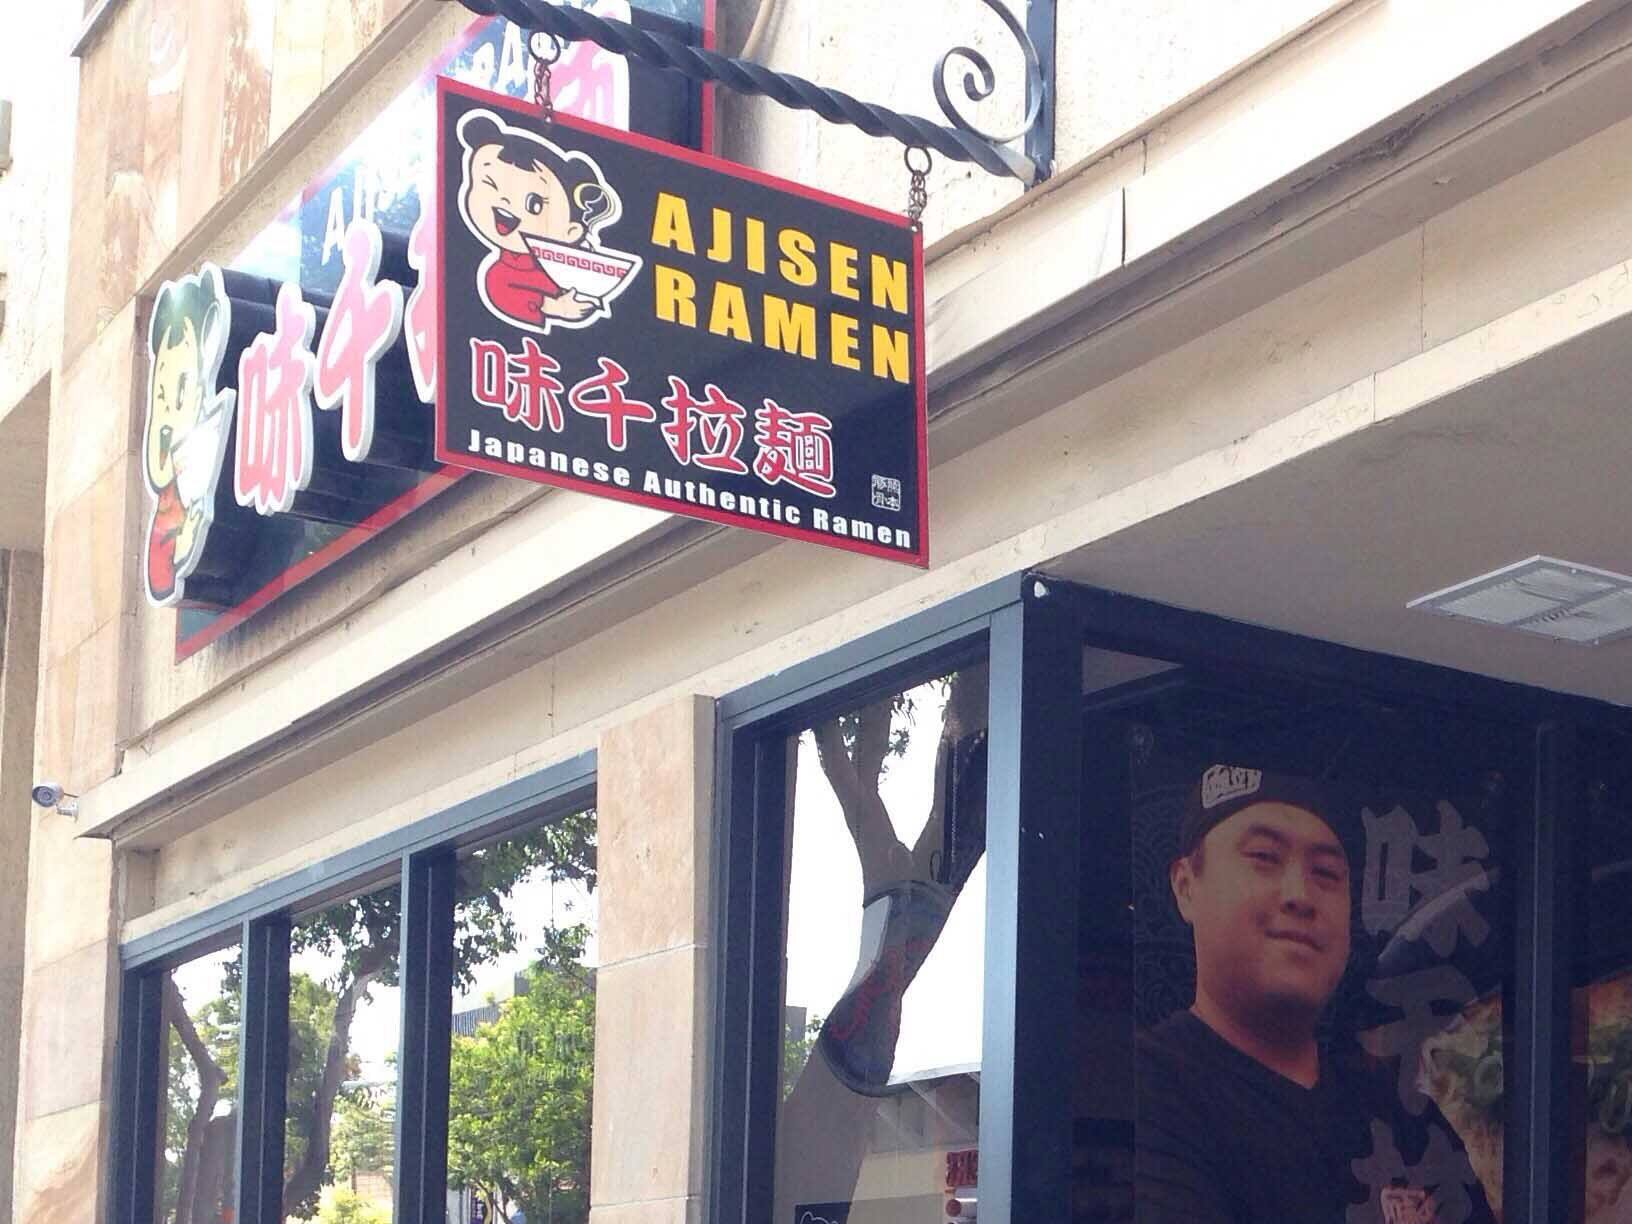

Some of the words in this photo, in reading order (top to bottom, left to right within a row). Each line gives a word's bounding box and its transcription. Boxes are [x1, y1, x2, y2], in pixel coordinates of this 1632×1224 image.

[651, 191, 909, 314] AJISEN
[653, 265, 911, 384] RAMEN
[469, 336, 836, 498] 味千拉麵
[467, 430, 630, 487] Japanese
[643, 472, 800, 525] Authentic
[812, 510, 912, 549] Ramen
